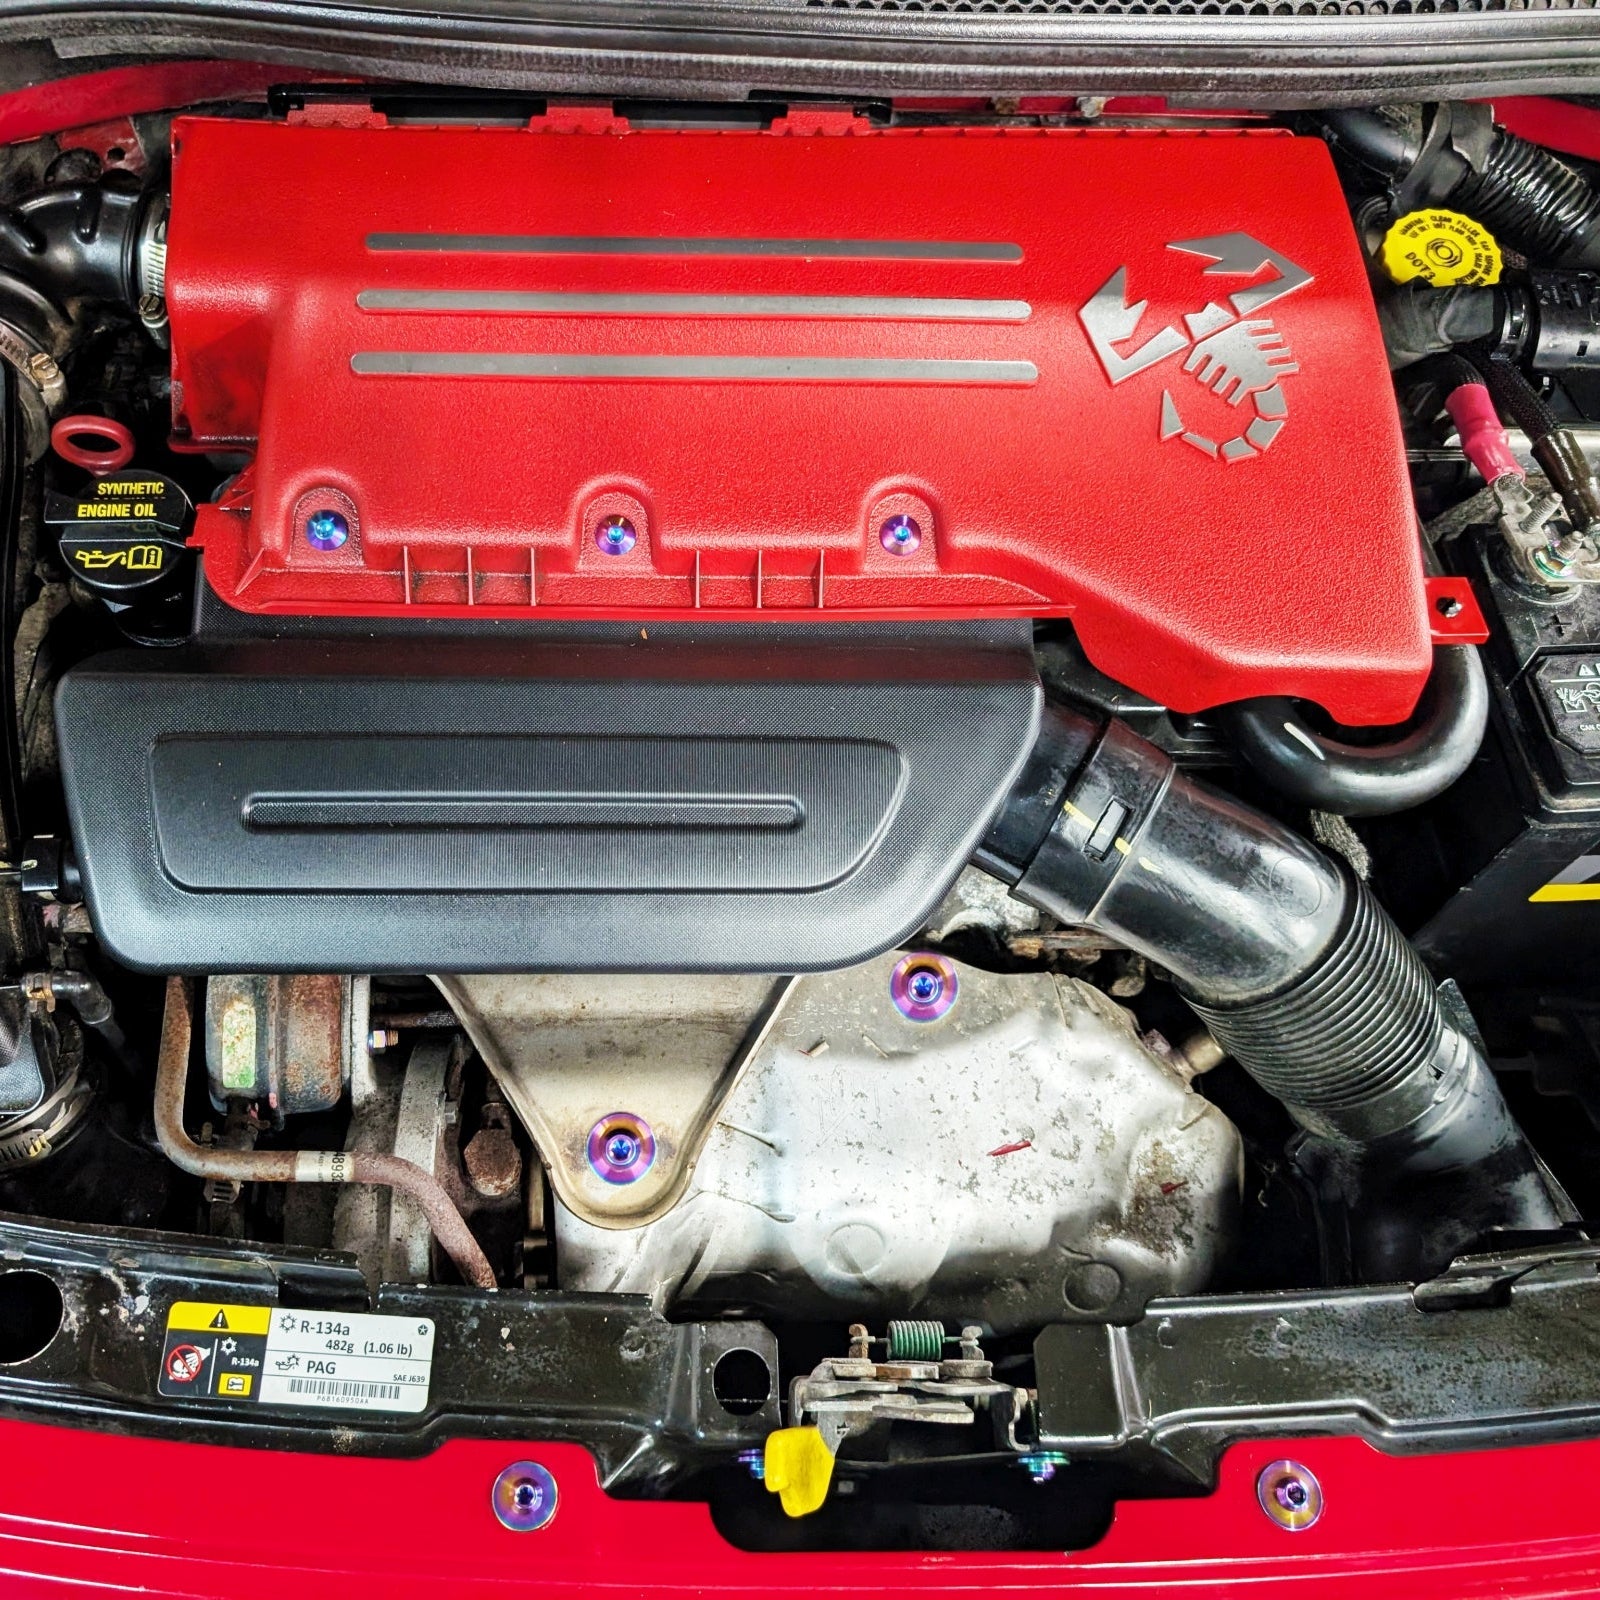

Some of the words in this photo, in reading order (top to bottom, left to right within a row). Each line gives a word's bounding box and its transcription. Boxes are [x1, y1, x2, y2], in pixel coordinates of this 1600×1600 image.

[98, 482, 164, 495] SYNTHETIC
[78, 504, 130, 517] ENGINE
[134, 504, 157, 517] OIL
[300, 1320, 350, 1337] R-134a
[325, 1339, 354, 1354] 482g
[363, 1340, 394, 1355] (1.06
[397, 1343, 413, 1357] lb)
[231, 1356, 260, 1367] R-134a
[307, 1360, 336, 1375] PAG
[408, 1375, 426, 1383] J639
